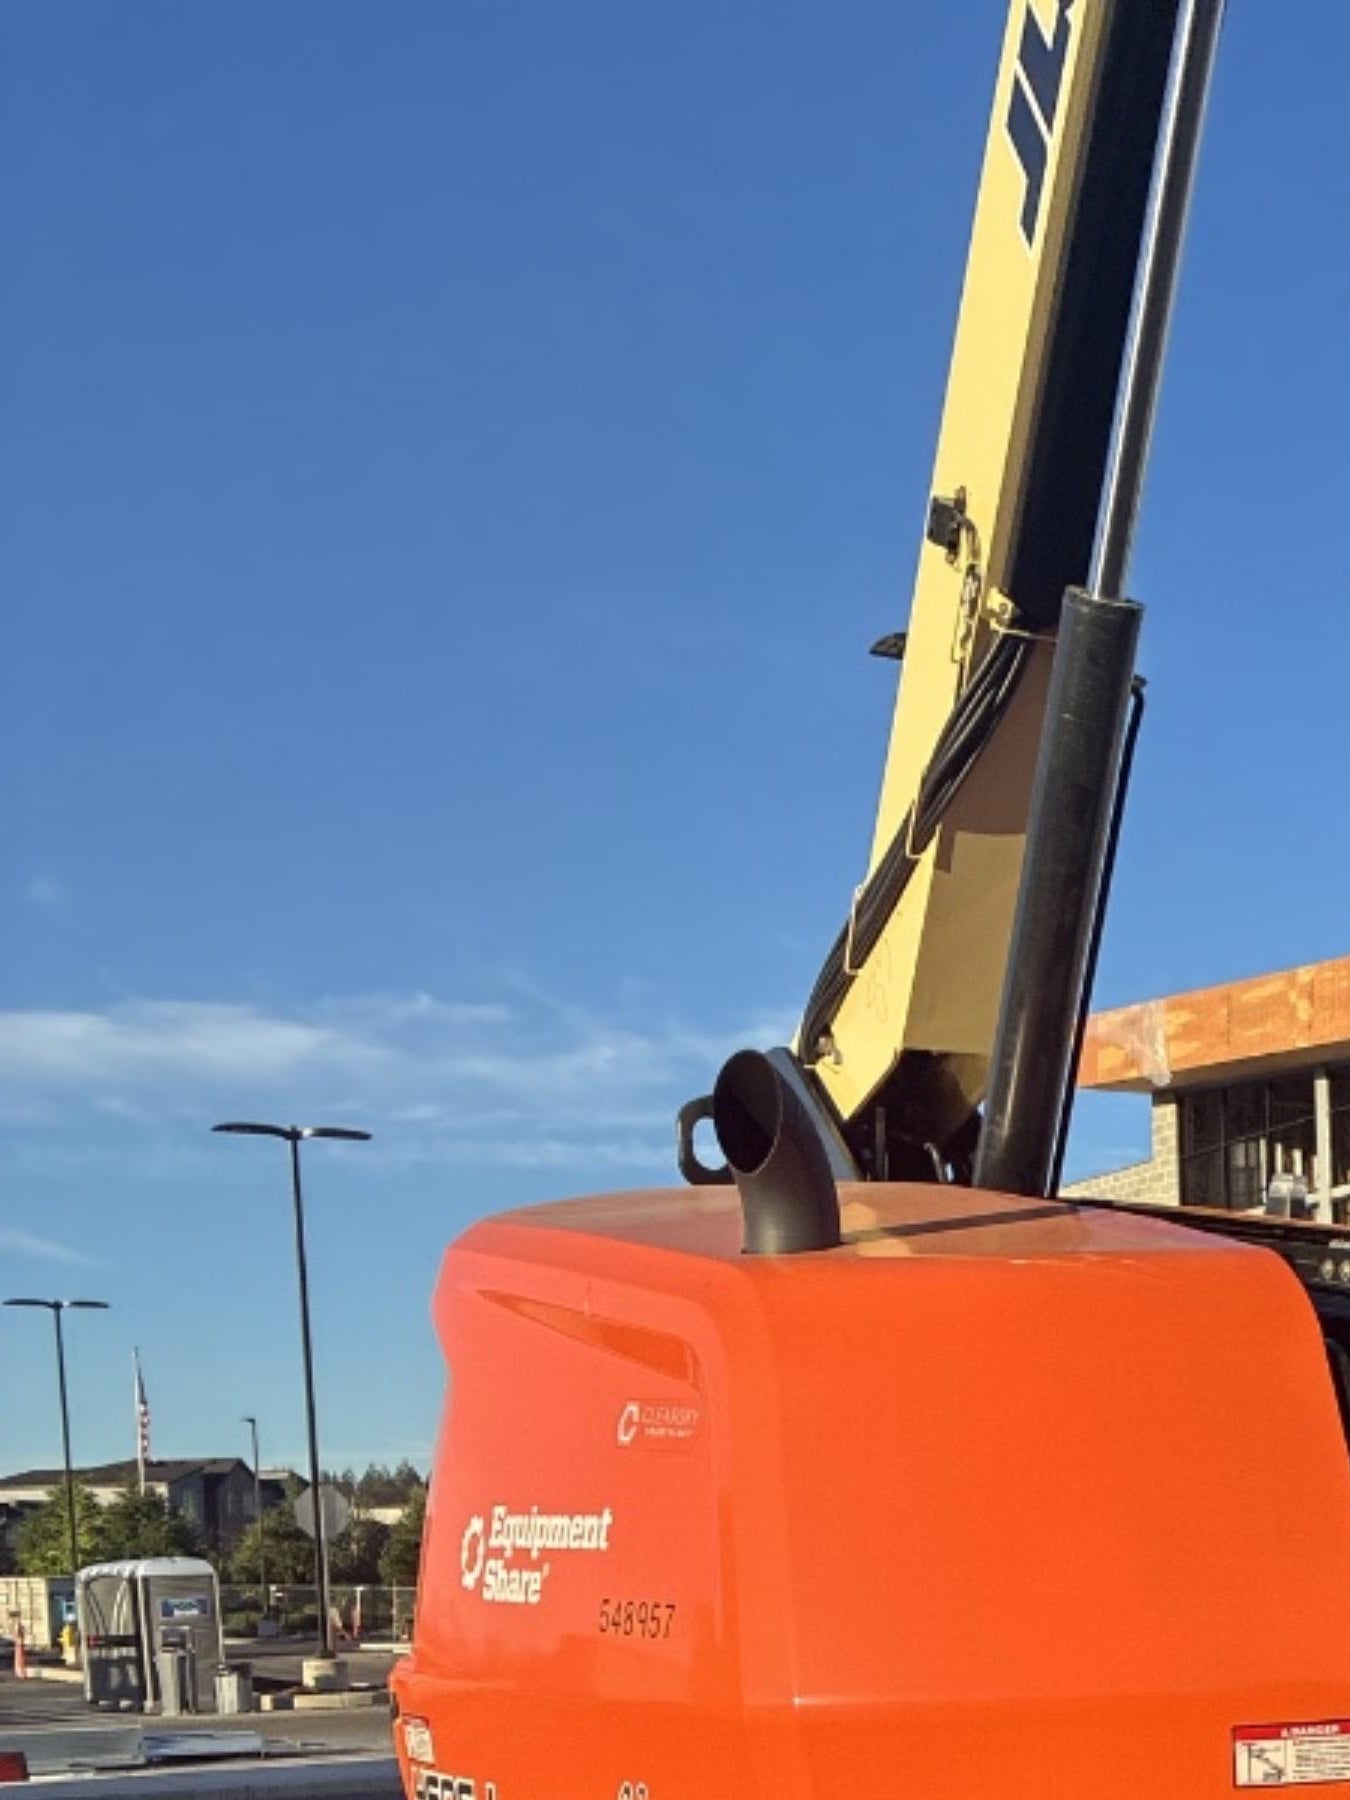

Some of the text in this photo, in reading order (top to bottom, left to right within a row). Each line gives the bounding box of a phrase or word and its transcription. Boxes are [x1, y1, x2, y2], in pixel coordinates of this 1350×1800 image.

[1004, 0, 1078, 250] JL
[488, 1504, 613, 1559] Equipment
[599, 1598, 676, 1639] 548957
